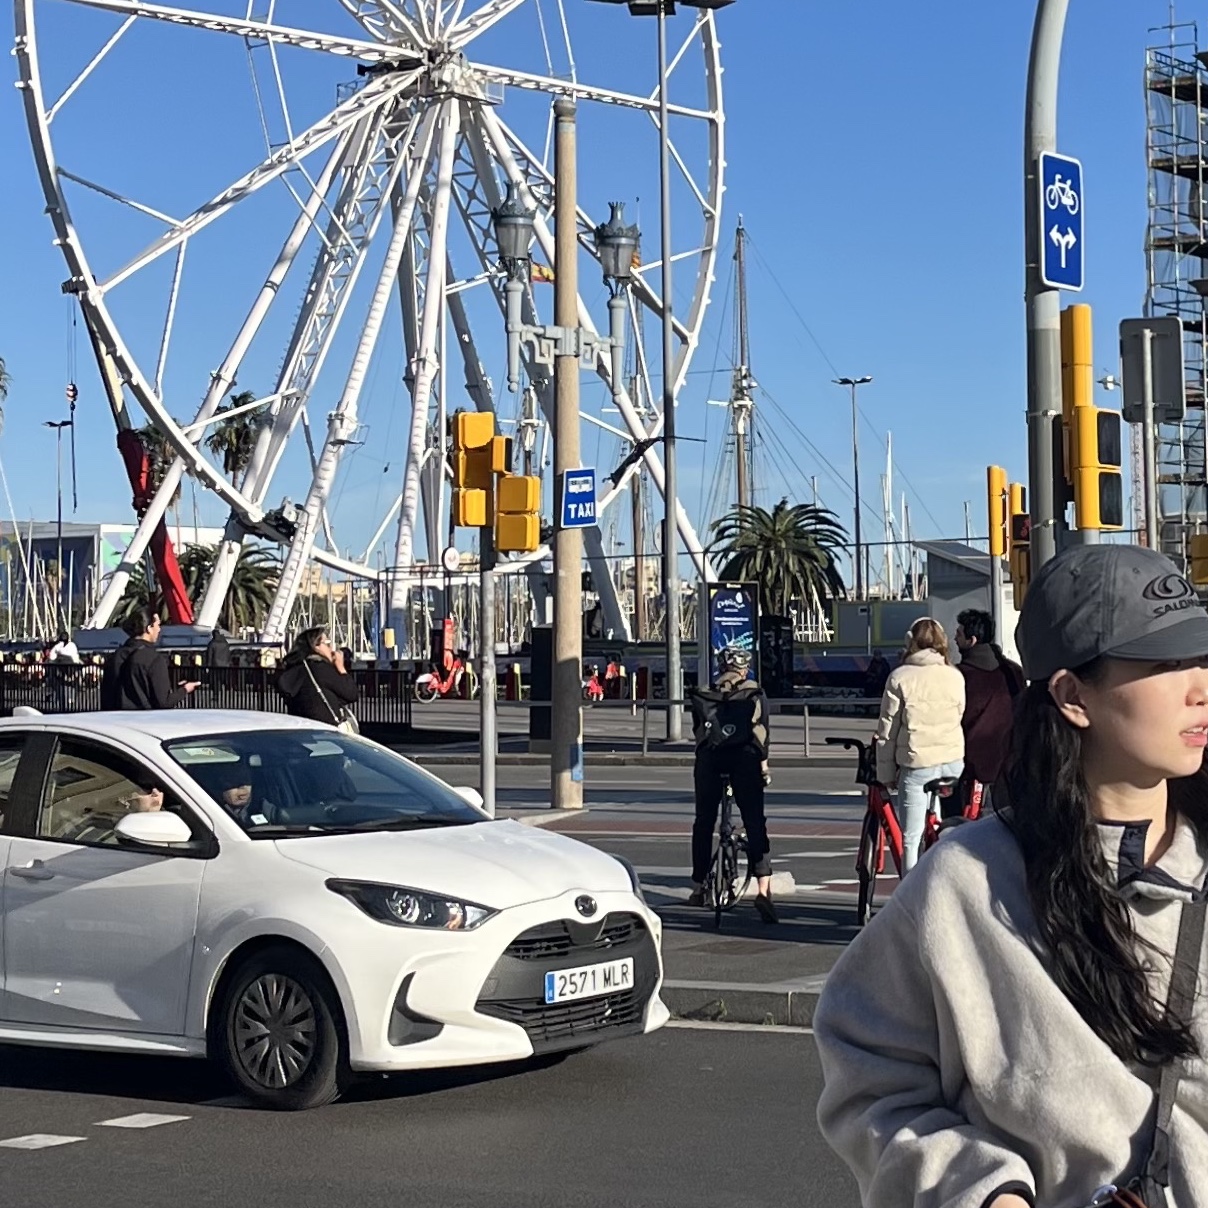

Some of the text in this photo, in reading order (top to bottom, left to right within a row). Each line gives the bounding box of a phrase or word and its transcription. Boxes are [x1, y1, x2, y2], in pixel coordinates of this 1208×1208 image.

[567, 502, 595, 519] TAXI
[558, 963, 630, 998] 2571 MLR
